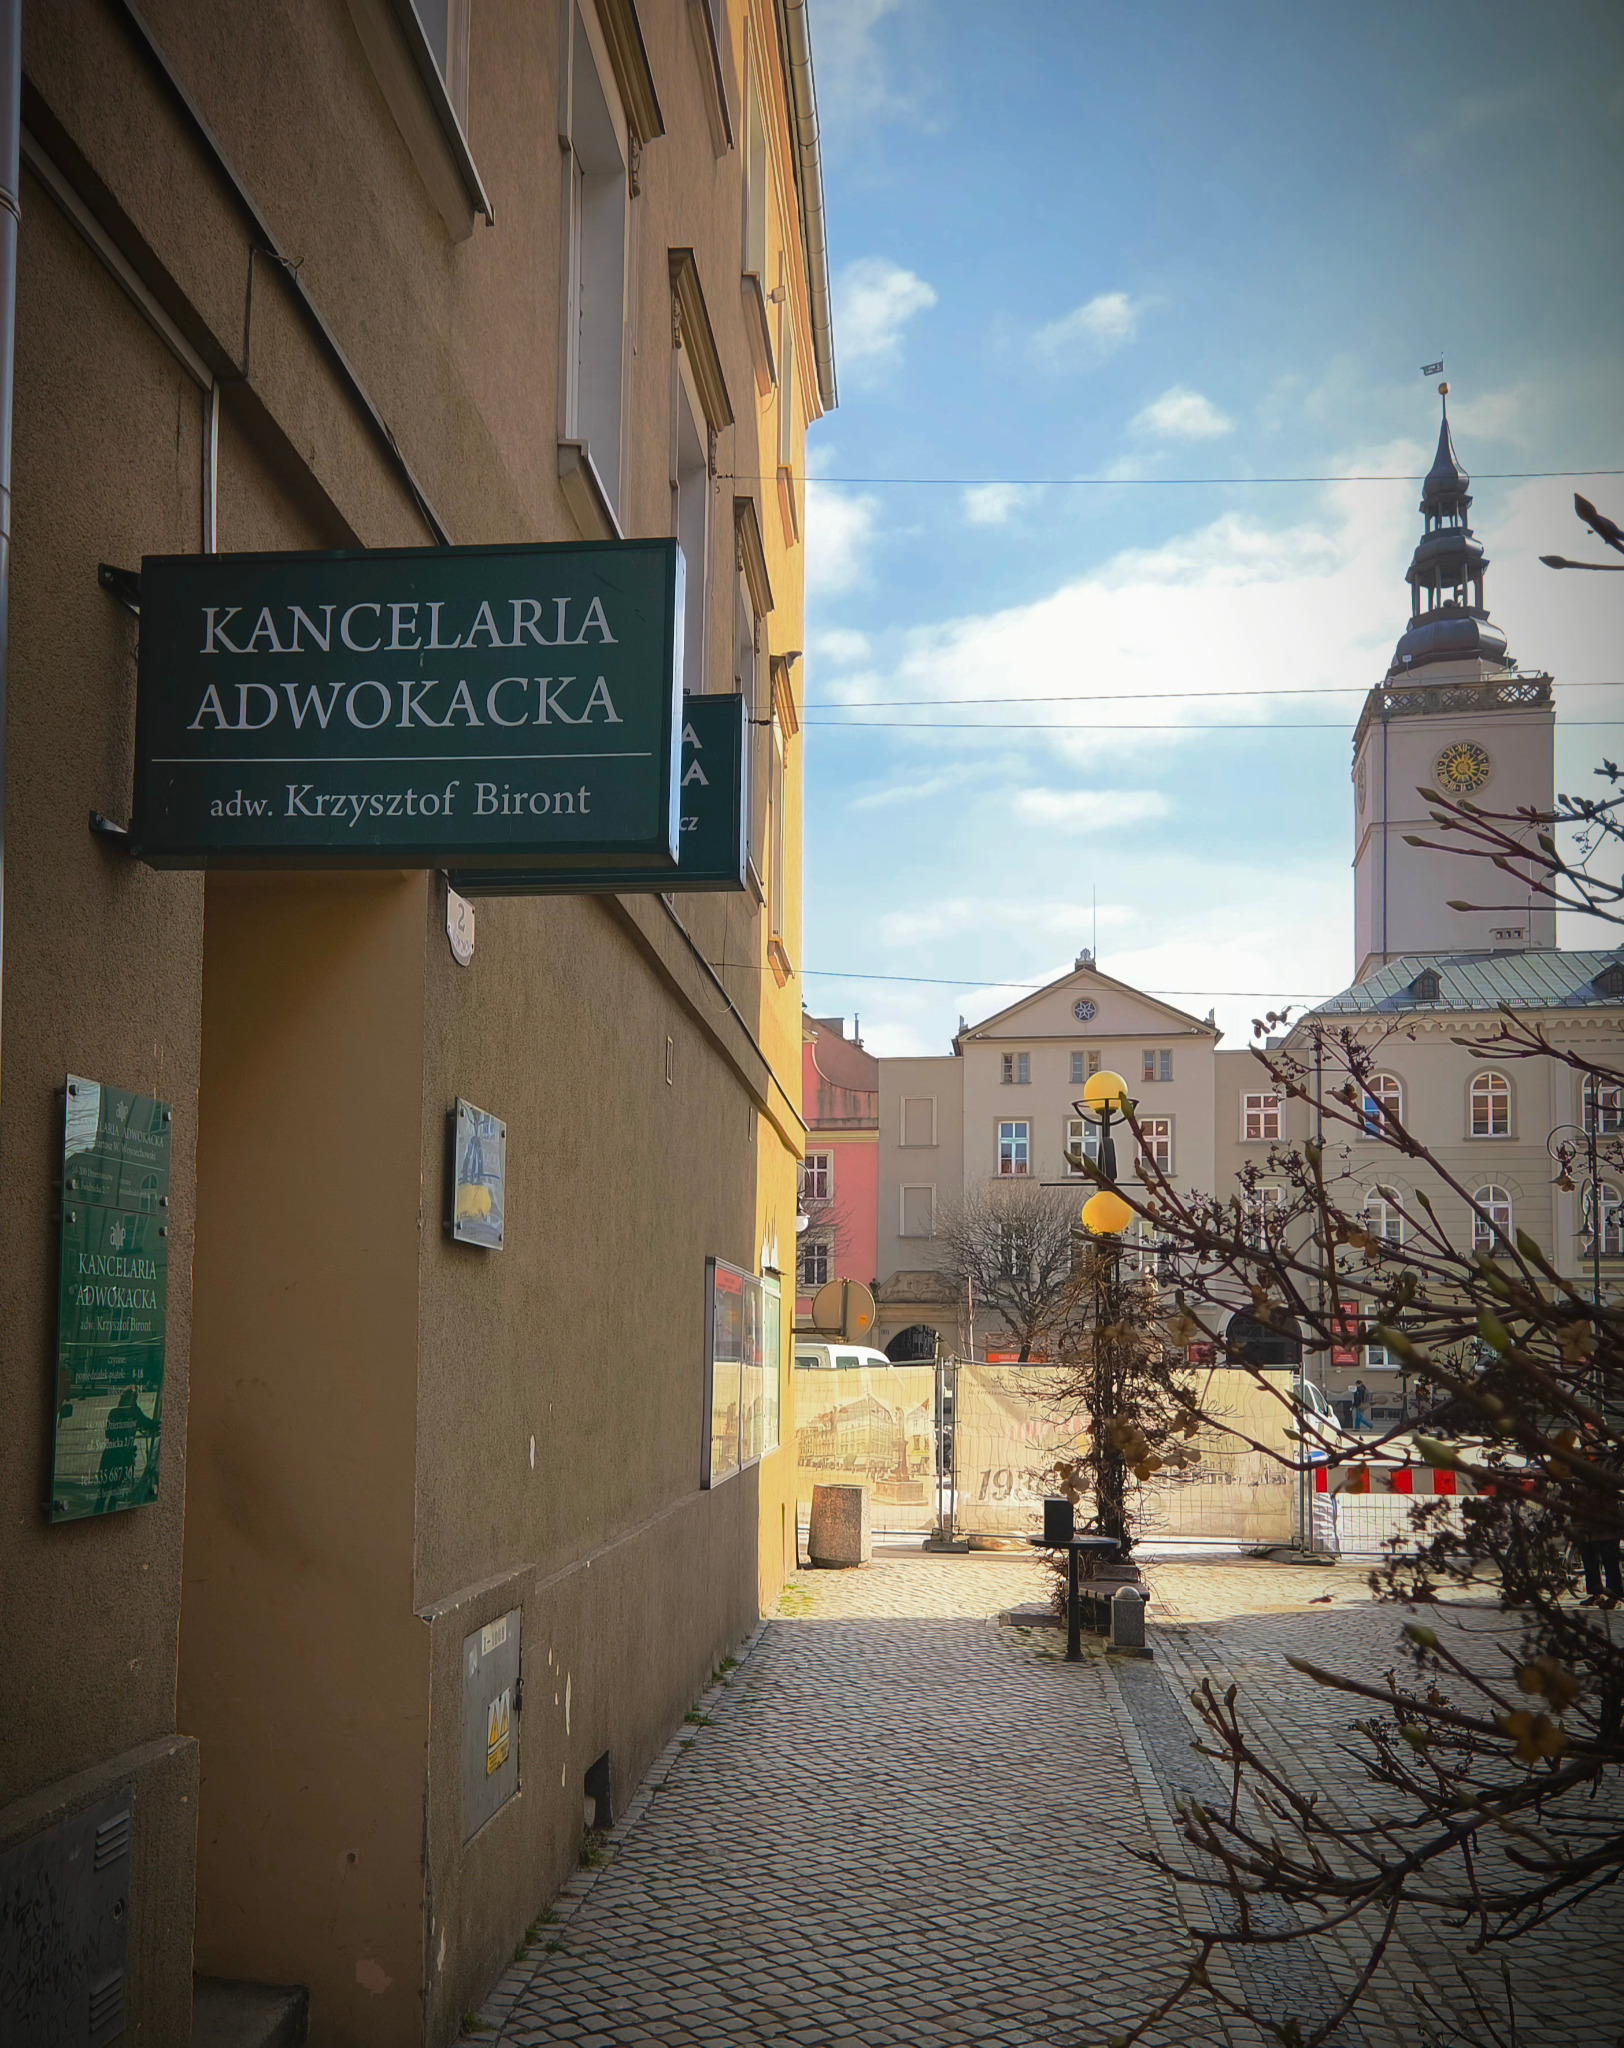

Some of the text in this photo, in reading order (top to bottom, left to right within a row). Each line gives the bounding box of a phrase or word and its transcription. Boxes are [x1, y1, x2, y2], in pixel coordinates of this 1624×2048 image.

[199, 596, 619, 655] KANCELARIA
[186, 675, 624, 731] ADWOKACKA
[210, 780, 591, 828] adw. Krzysztof Biront
[458, 903, 465, 933] 2
[78, 1252, 158, 1280] KANCELARIA
[75, 1284, 158, 1310] ADWOKACKA
[97, 1316, 130, 1333] Krzysztof
[130, 1316, 152, 1332] Biront
